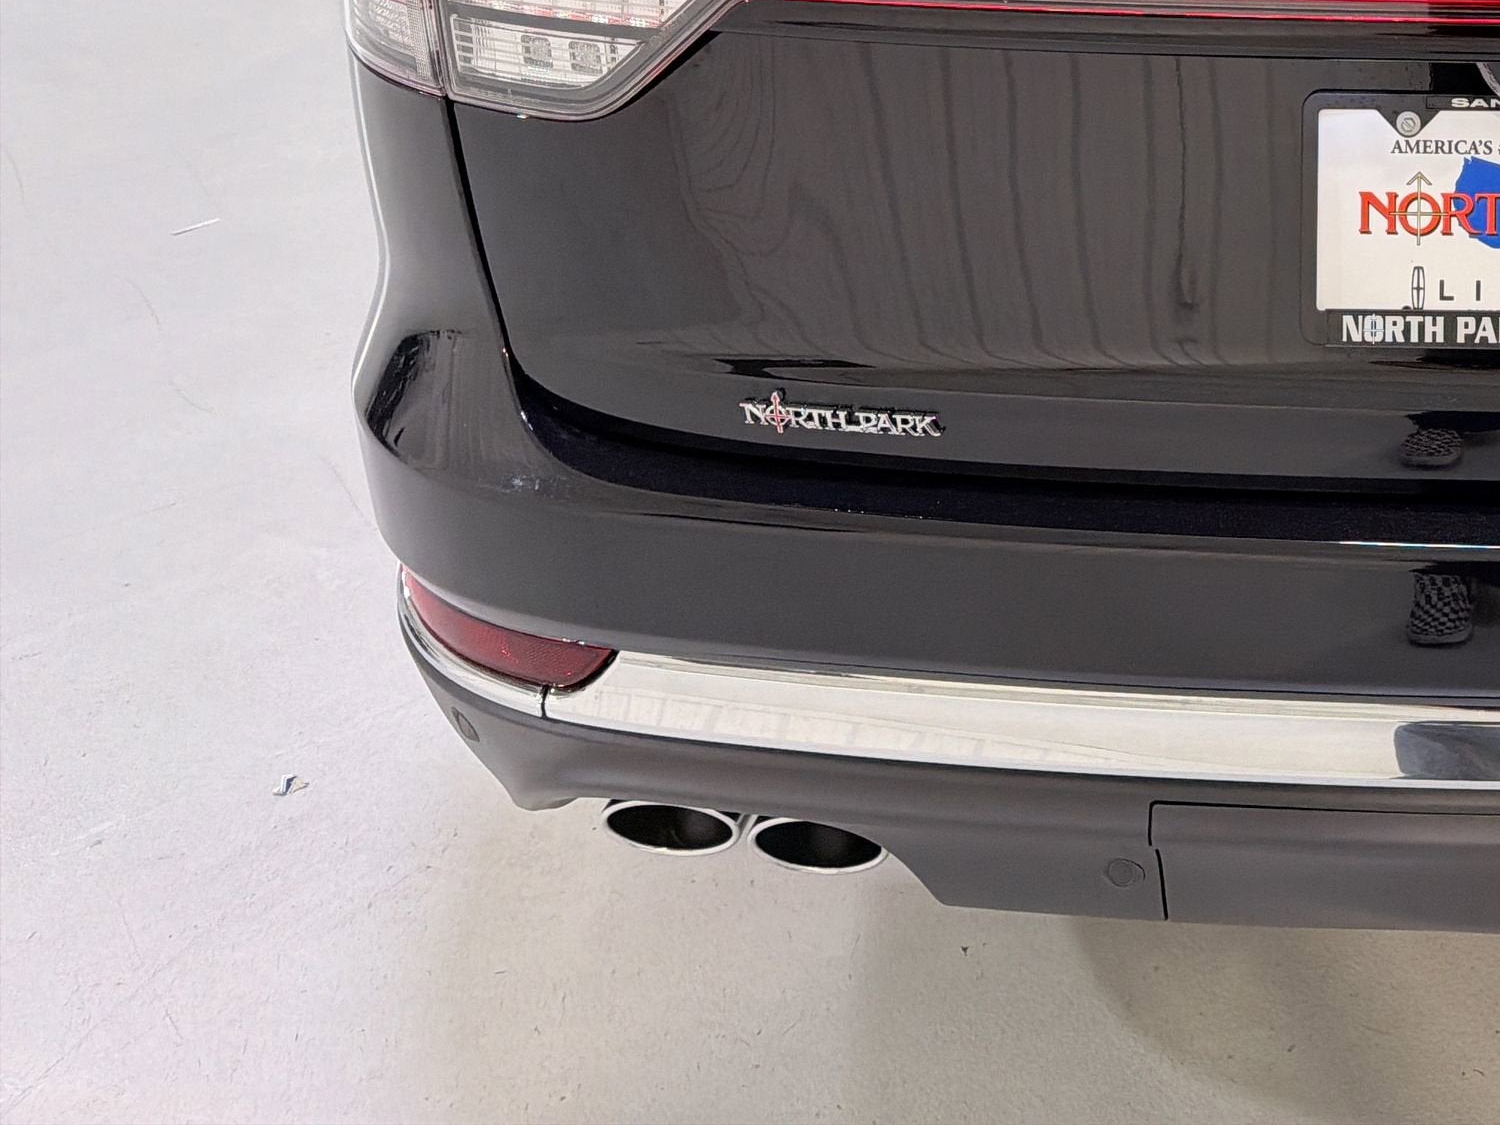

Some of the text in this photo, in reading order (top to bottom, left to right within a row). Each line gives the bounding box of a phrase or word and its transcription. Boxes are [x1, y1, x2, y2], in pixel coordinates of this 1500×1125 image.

[1391, 139, 1493, 156] AMERICA'S
[1342, 315, 1445, 344] NORTH
[739, 396, 942, 437] NORTH PARK
